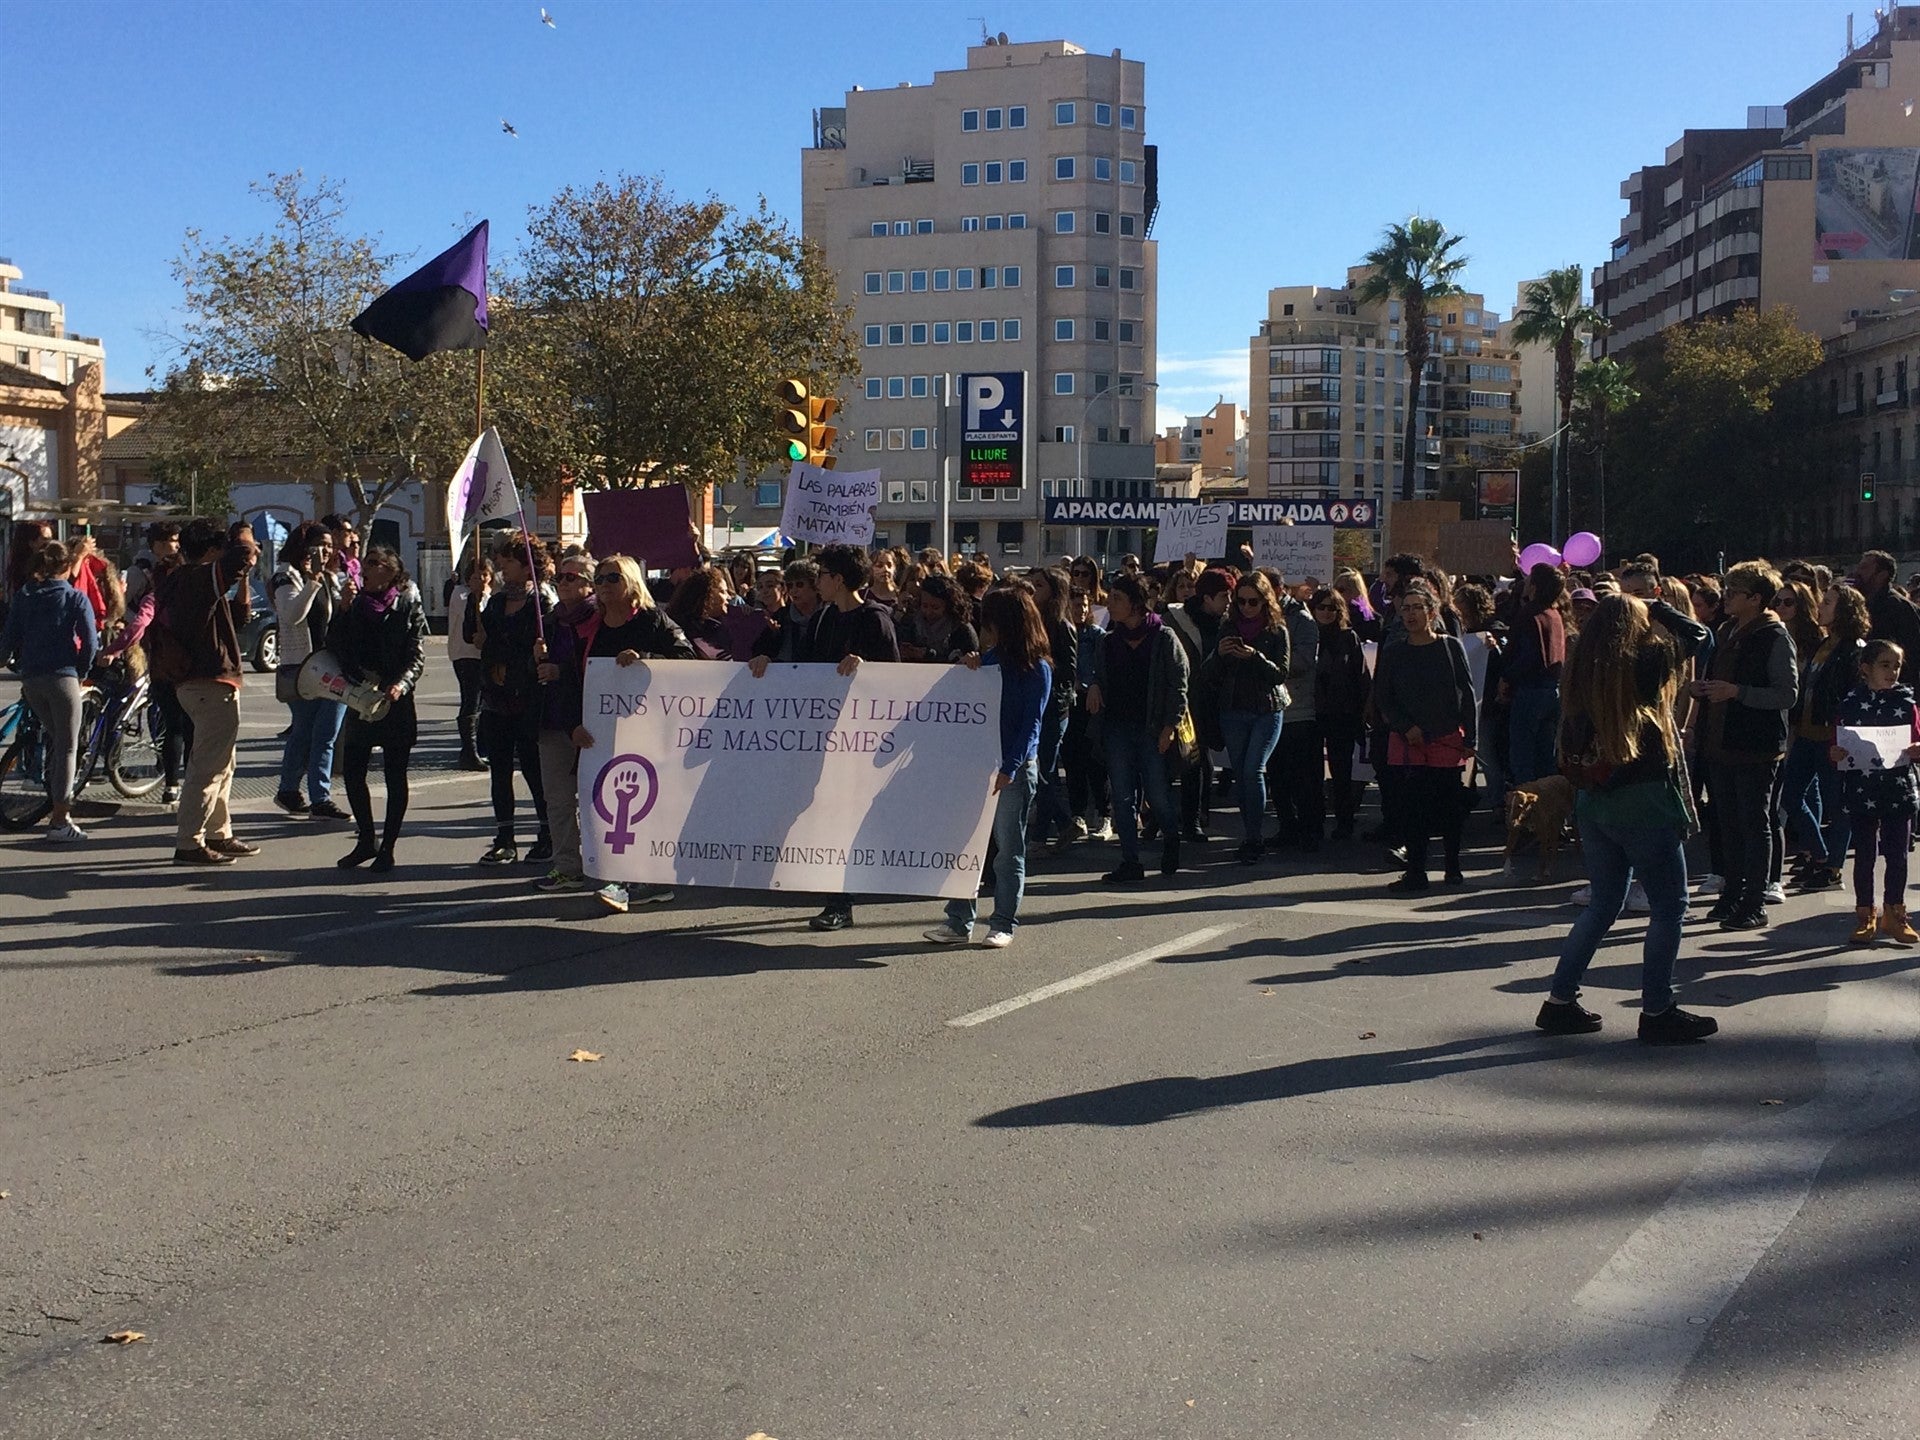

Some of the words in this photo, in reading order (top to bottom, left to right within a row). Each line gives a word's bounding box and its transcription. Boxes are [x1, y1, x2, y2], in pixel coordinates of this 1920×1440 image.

[966, 376, 1005, 430] P
[970, 448, 1008, 461] LLIURE
[798, 471, 823, 494] LAS
[826, 480, 877, 498] PALABRAS
[797, 514, 847, 534] MATAN
[1238, 503, 1327, 522] ENTRADA
[1179, 526, 1203, 539] ENS
[598, 693, 648, 715] ENS
[659, 695, 757, 719] VOLEM
[765, 698, 841, 720] VIVES
[851, 698, 860, 720] I
[870, 699, 987, 725] LLIURES
[677, 727, 713, 750] DE
[723, 729, 895, 754] MASCLISMES
[650, 840, 746, 861] MOVIMENT
[752, 845, 848, 866] FEMINISTA
[853, 849, 875, 866] DE
[881, 850, 981, 872] MALLORCA
